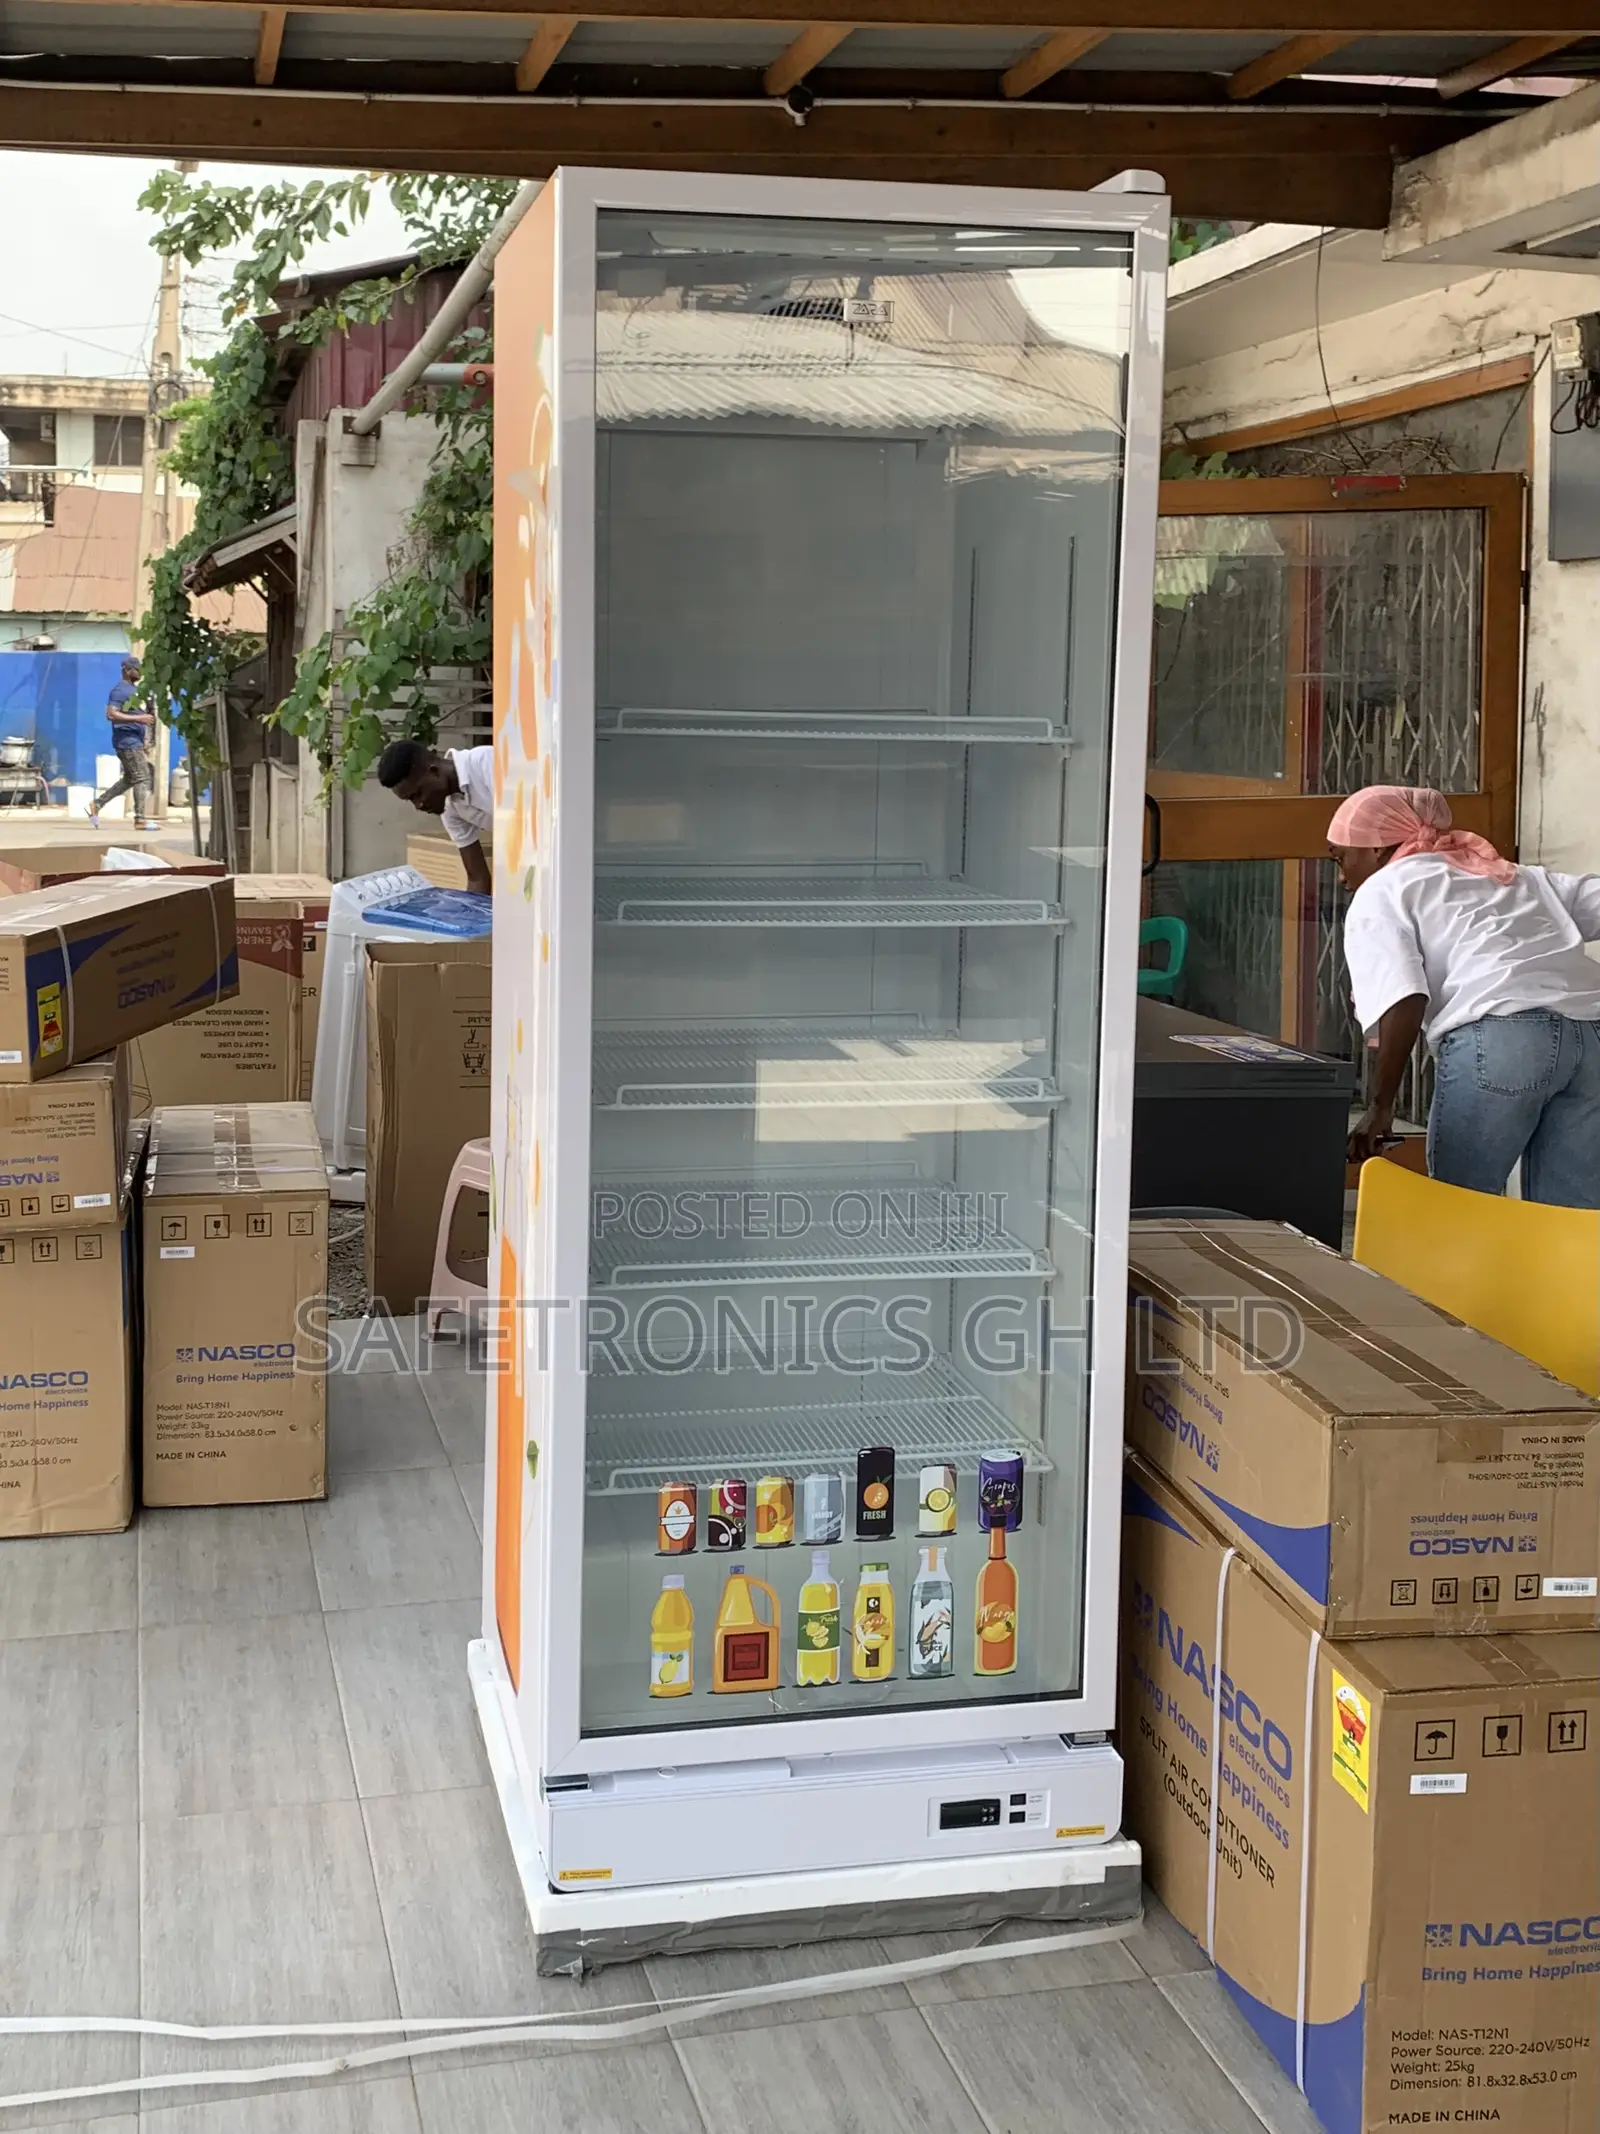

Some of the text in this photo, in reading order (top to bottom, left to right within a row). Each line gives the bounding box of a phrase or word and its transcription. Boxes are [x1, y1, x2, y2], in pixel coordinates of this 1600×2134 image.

[852, 303, 888, 316] ZARA
[236, 936, 272, 945] ENERG
[0, 1172, 43, 1187] NAS
[198, 1343, 295, 1362] NASCO
[176, 1371, 295, 1385] Bring Home Happiness
[34, 1398, 89, 1411] Happiness
[156, 1410, 284, 1422] Power Source: 220-240V/50Hz
[1142, 1383, 1206, 1459] NASCO
[157, 1423, 188, 1432] Weight:
[1521, 1436, 1549, 1445] CHINA
[1561, 1435, 1586, 1444] MADE
[59, 1457, 72, 1465] cm
[156, 1450, 227, 1460] MADE IN CHINA
[1560, 1471, 1584, 1479] Power
[0, 1481, 21, 1489] HINA
[863, 1510, 887, 1520] FRESH
[1410, 1510, 1538, 1526] Bring Home Happiness
[1409, 1535, 1514, 1556] NASCO
[1157, 1607, 1293, 1781] NASCO
[1167, 1695, 1208, 1758] Home
[1139, 1716, 1168, 1759] SPLIT
[1169, 1753, 1189, 1787] AIR
[1229, 1731, 1291, 1809] electronics
[1163, 1772, 1211, 1841] (Outdoor
[1547, 1942, 1600, 1956] electroni
[1421, 1960, 1600, 1984] Bring Home Happines
[1391, 2028, 1509, 2042] Model: NAS-T12N1
[1391, 2037, 1590, 2058] Power Source: 220-240V/50Hz
[1391, 2060, 1475, 2075] Weight: 25kg
[1390, 2070, 1577, 2091] Dimension: 81.8x32.8x53.0 cm
[1388, 2108, 1501, 2125] MADE IN CHINA
